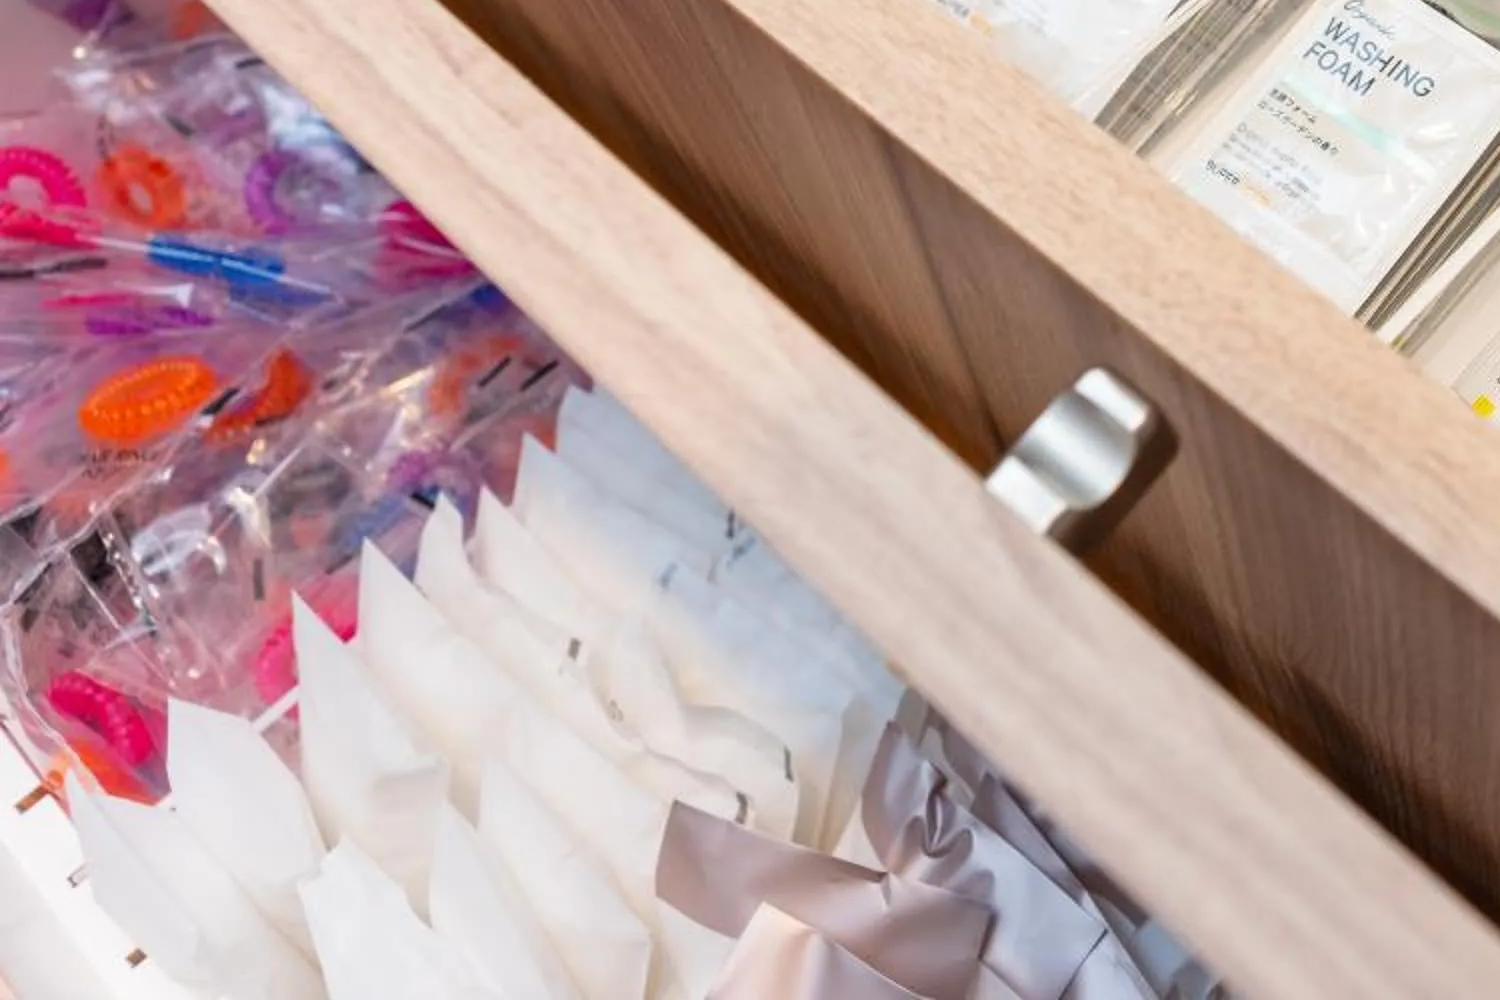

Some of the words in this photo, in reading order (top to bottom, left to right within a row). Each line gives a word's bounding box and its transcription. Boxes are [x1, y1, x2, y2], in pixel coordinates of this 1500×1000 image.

[1344, 0, 1396, 40] Organic
[1303, 41, 1376, 96] FOAM
[1325, 17, 1435, 99] WASHING
